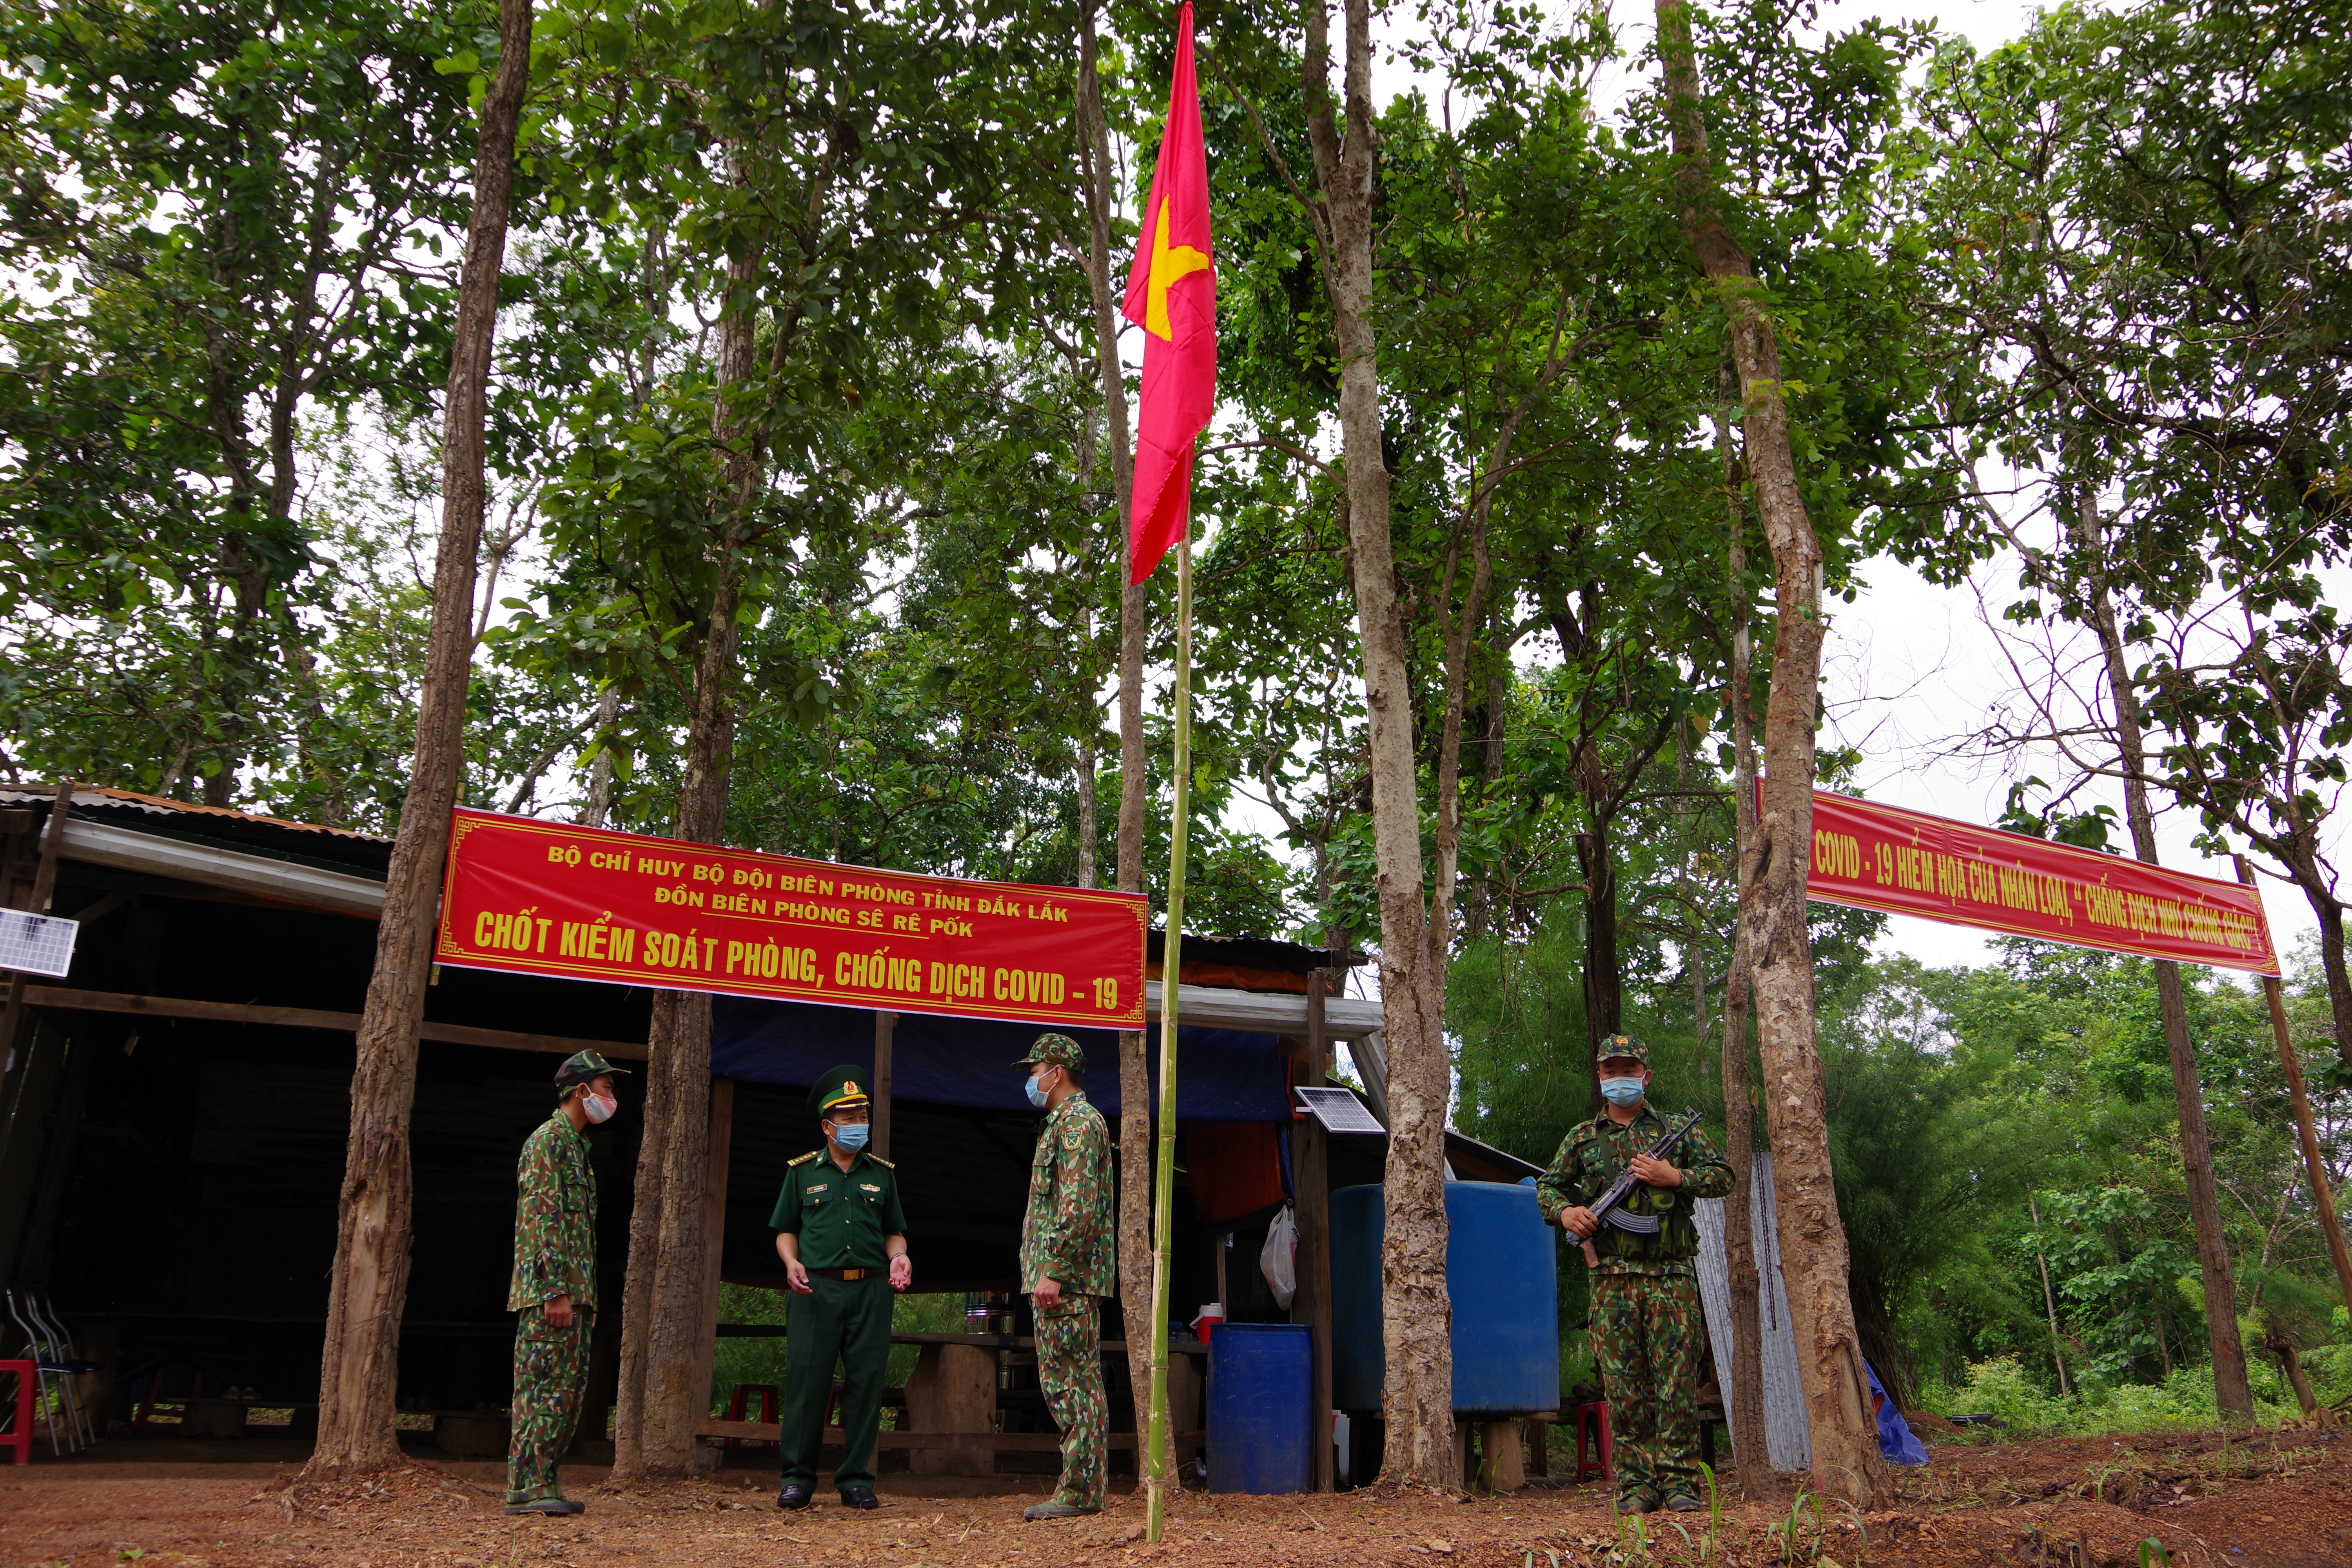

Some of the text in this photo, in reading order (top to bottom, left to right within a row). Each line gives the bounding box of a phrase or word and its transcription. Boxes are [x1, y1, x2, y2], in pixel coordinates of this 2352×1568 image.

[548, 845, 1067, 922] BỘ CHỈ HUY BỘ ĐỘI BIÊN PHÒNG TỈNH ĐẮK LẮK
[655, 884, 973, 937] ĐỒN BIÊN PHÒNG SÊ RÊ PỐK
[1815, 829, 1860, 879] COVID
[1875, 842, 1893, 885] 19
[1896, 828, 1934, 893] HIỂM
[1937, 854, 1967, 906] HỌA
[1969, 847, 1998, 904] CỦA
[1999, 860, 2037, 911] NHÂN
[2039, 875, 2073, 927] LOẠI,
[2085, 873, 2128, 928] CHỐNG
[2127, 893, 2158, 940] DỊCH
[2157, 895, 2183, 938] NHƯ
[2183, 893, 2225, 945] CHỐNG
[475, 906, 552, 953] CHỐT
[559, 911, 635, 962] KIỂM
[643, 929, 718, 971] SOÁT
[726, 938, 825, 988] PHÒNG,
[835, 946, 921, 992] CHỐNG
[930, 962, 985, 1003] DỊCH
[994, 968, 1064, 1004] COVID
[1093, 978, 1117, 1009] 19
